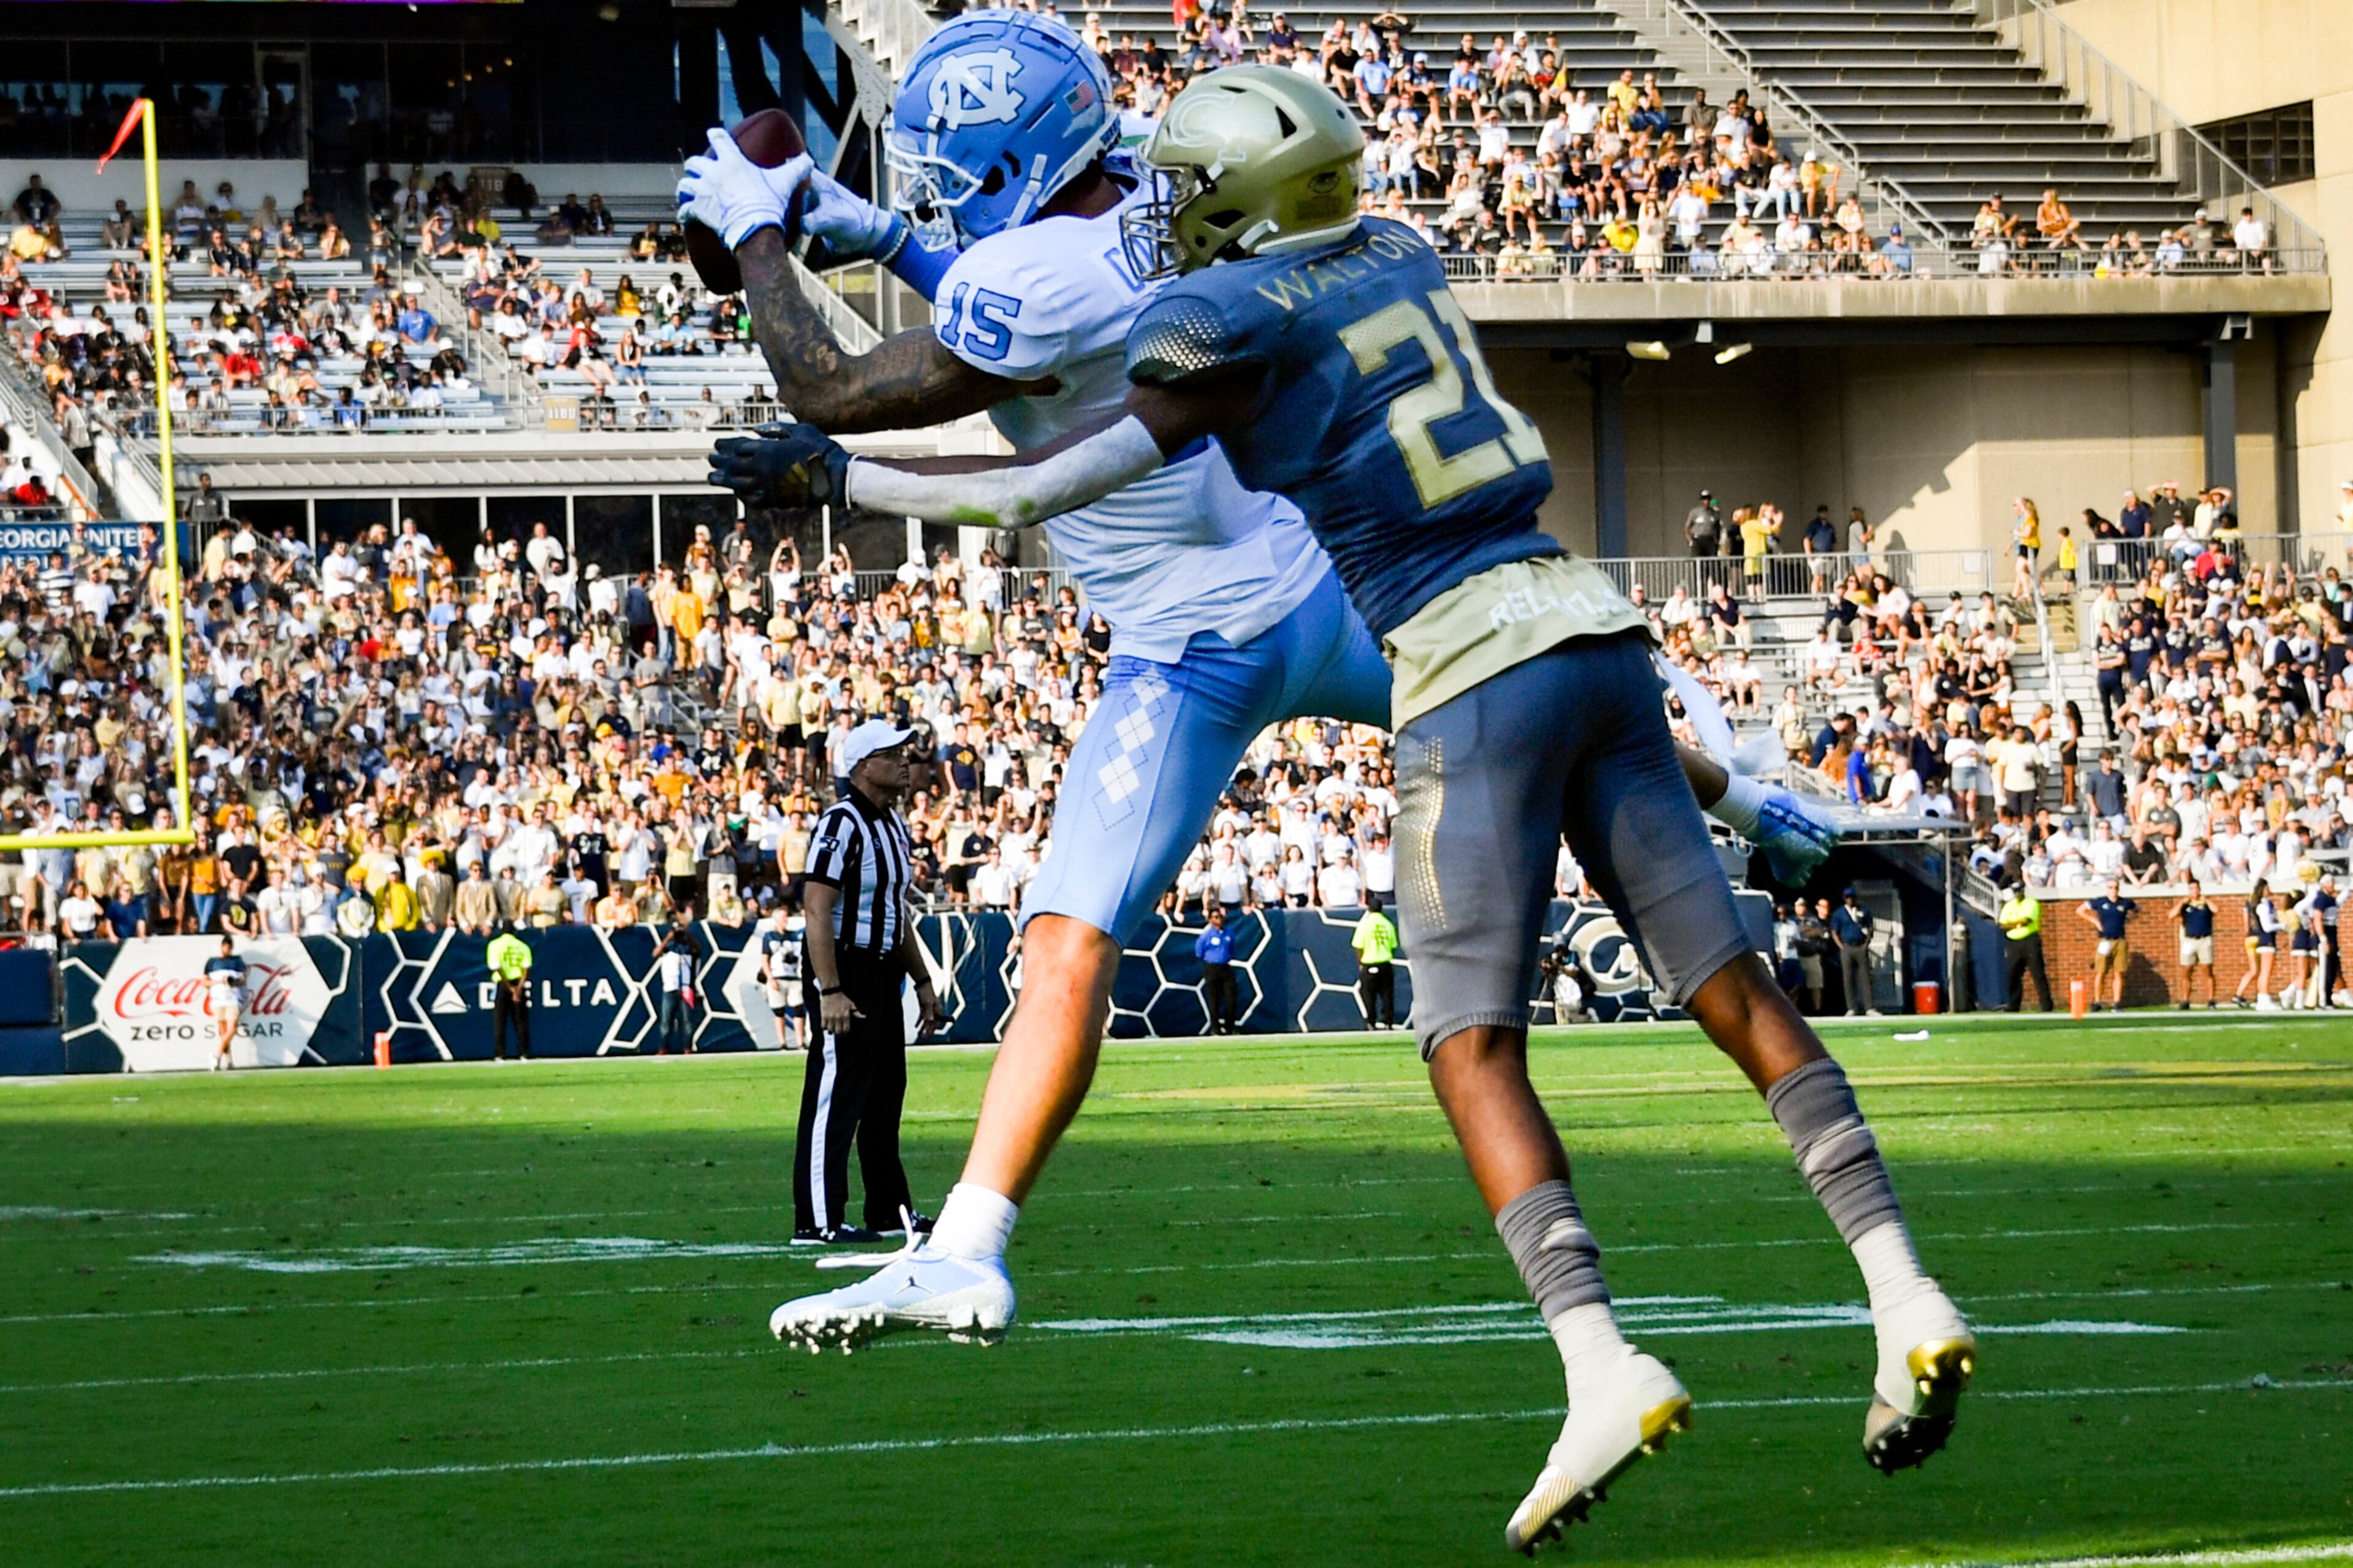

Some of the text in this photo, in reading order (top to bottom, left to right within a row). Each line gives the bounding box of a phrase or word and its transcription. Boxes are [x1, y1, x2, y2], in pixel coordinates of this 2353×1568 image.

[1256, 227, 1423, 311] WALTON
[941, 281, 1022, 362] 15
[1336, 289, 1550, 510] 21
[131, 1021, 283, 1041] zero SGAR
[479, 979, 617, 1010] DLTA
